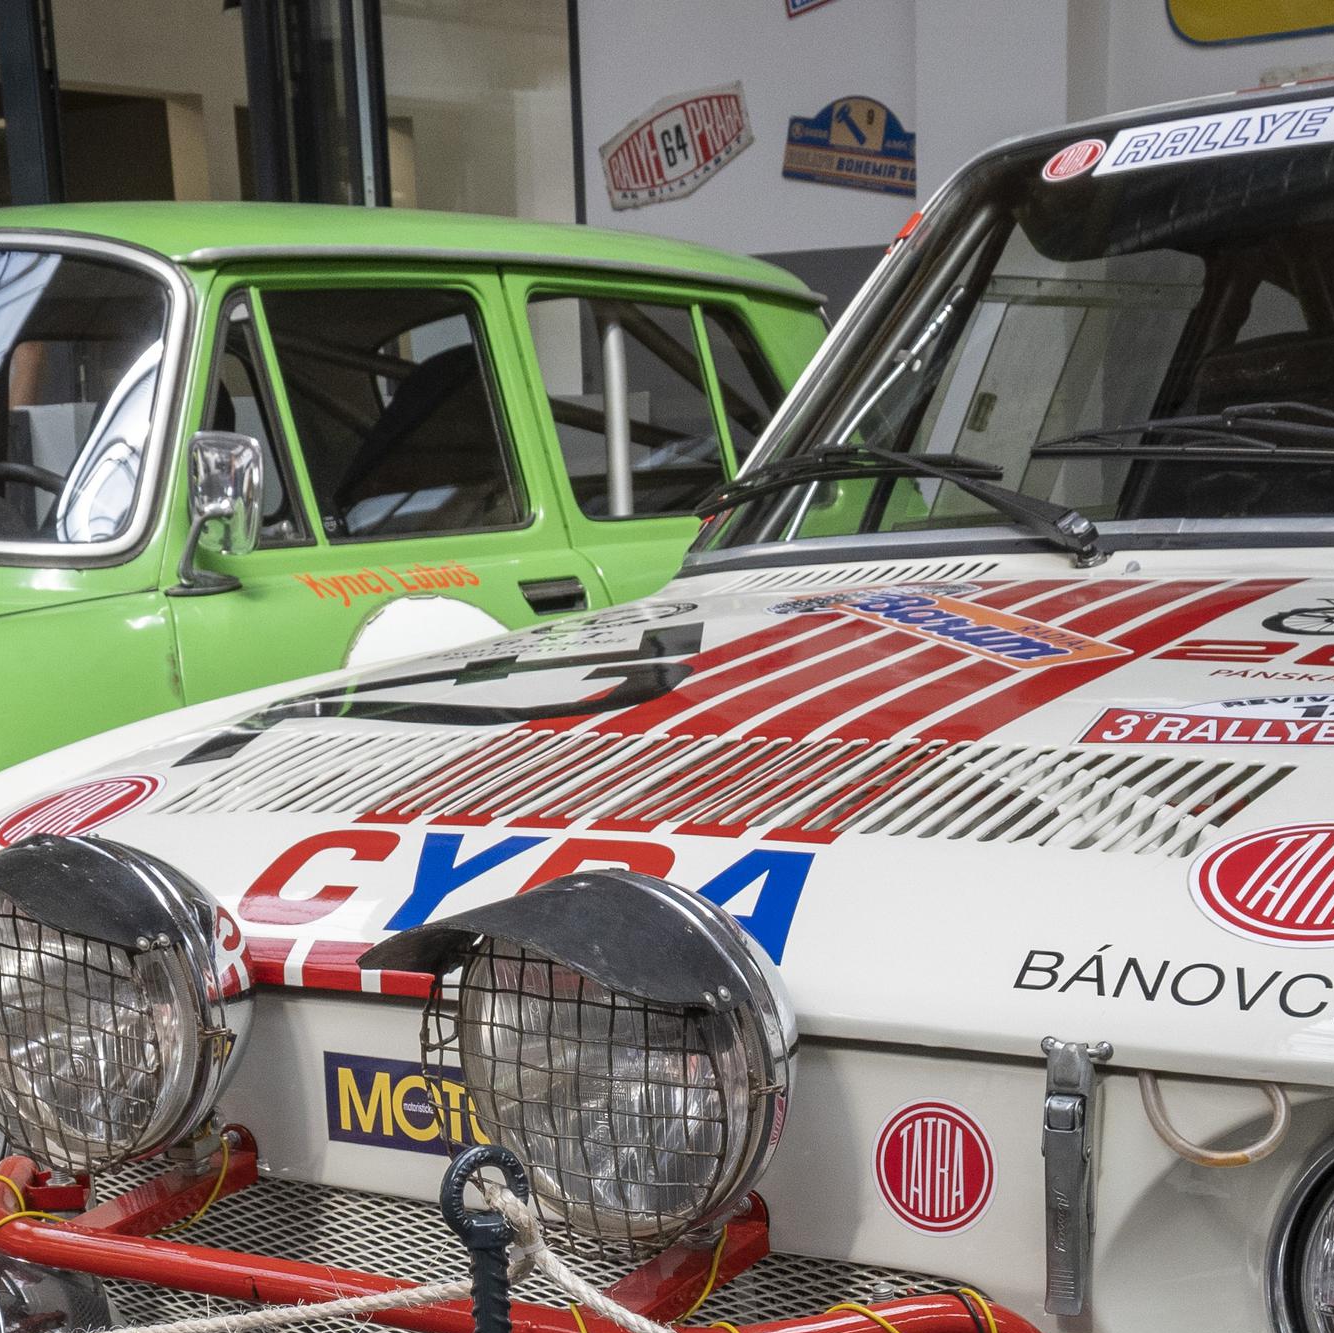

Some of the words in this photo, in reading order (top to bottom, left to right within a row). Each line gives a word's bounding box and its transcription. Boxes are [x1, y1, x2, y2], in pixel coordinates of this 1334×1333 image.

[610, 126, 665, 188] RALLYE
[661, 124, 689, 167] 64
[686, 97, 744, 165] PRAHA
[1115, 104, 1334, 168] RALLYE
[295, 565, 394, 608] Kyncl
[854, 593, 1072, 661] Barum
[1017, 624, 1095, 652] RADIAL
[899, 1116, 965, 1219] TATRA
